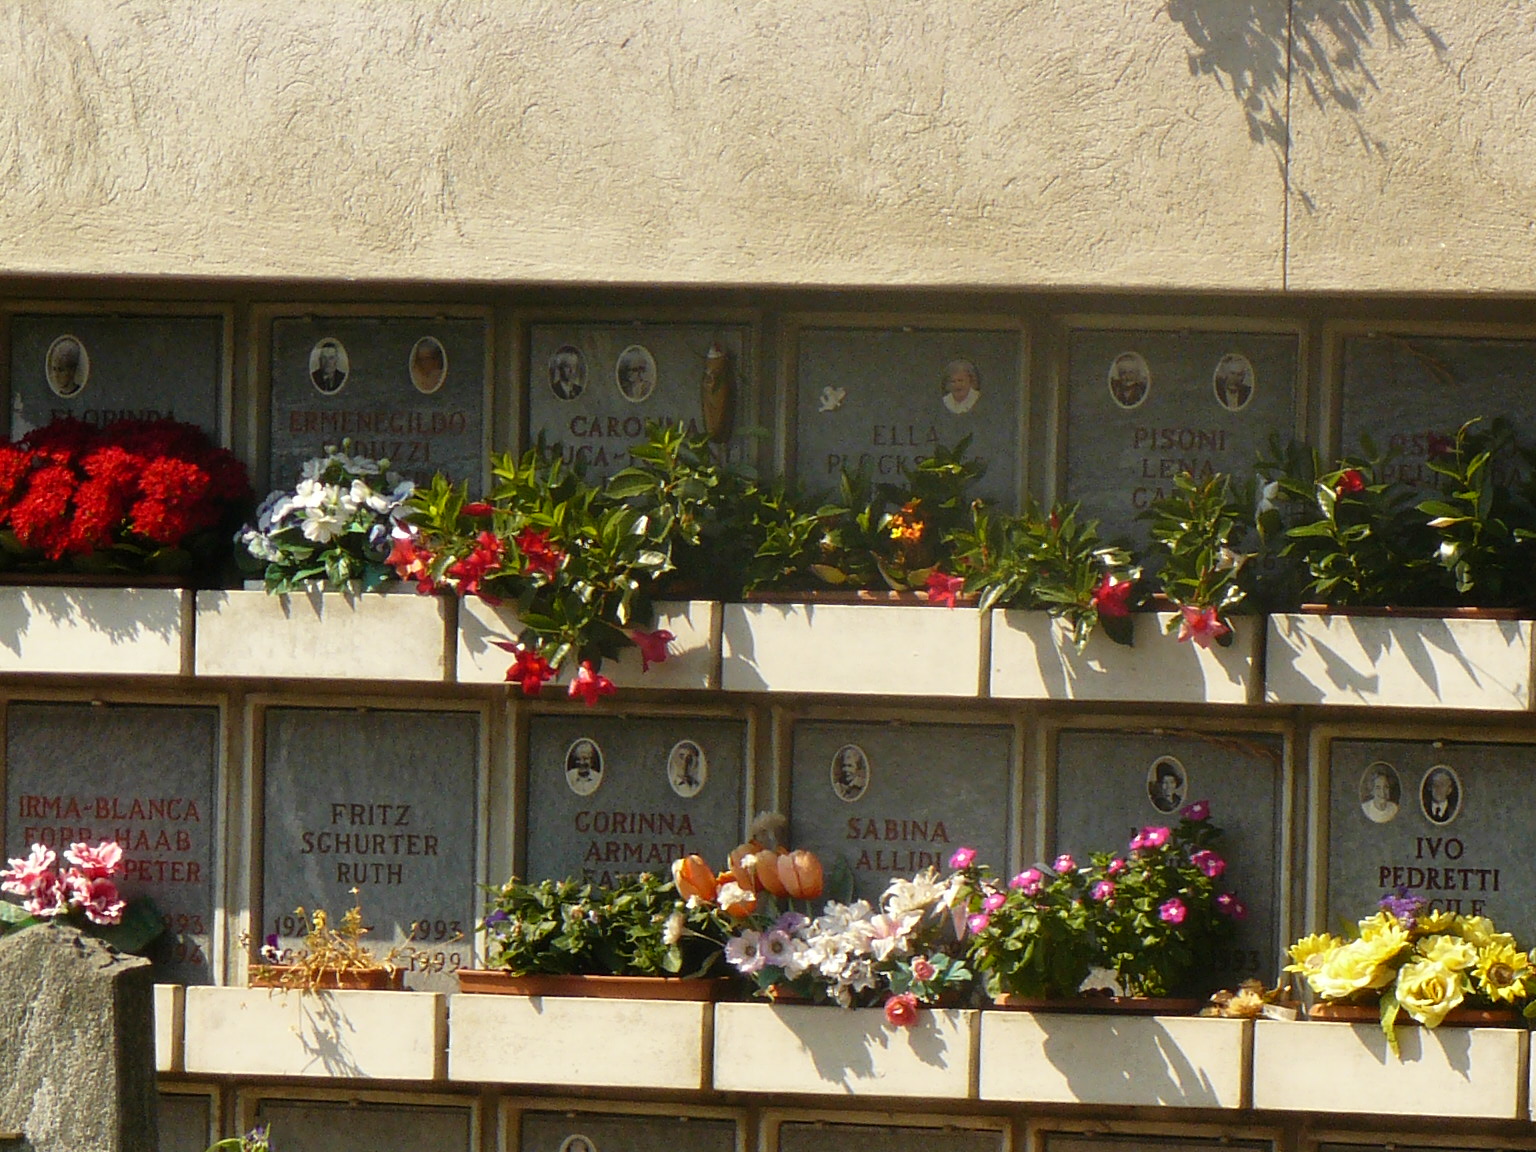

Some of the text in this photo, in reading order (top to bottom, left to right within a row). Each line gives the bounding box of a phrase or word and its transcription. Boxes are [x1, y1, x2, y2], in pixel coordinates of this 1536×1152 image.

[873, 425, 942, 447] ELLA
[1132, 426, 1226, 451] PISONI
[331, 802, 412, 827] FRITZ
[574, 810, 696, 837] CORINNA
[845, 815, 951, 843] SABINA
[301, 831, 440, 857] SCHURTER
[1415, 836, 1465, 861] IVO
[336, 861, 403, 885] RUTH
[1378, 865, 1501, 893] PEDRETTI
